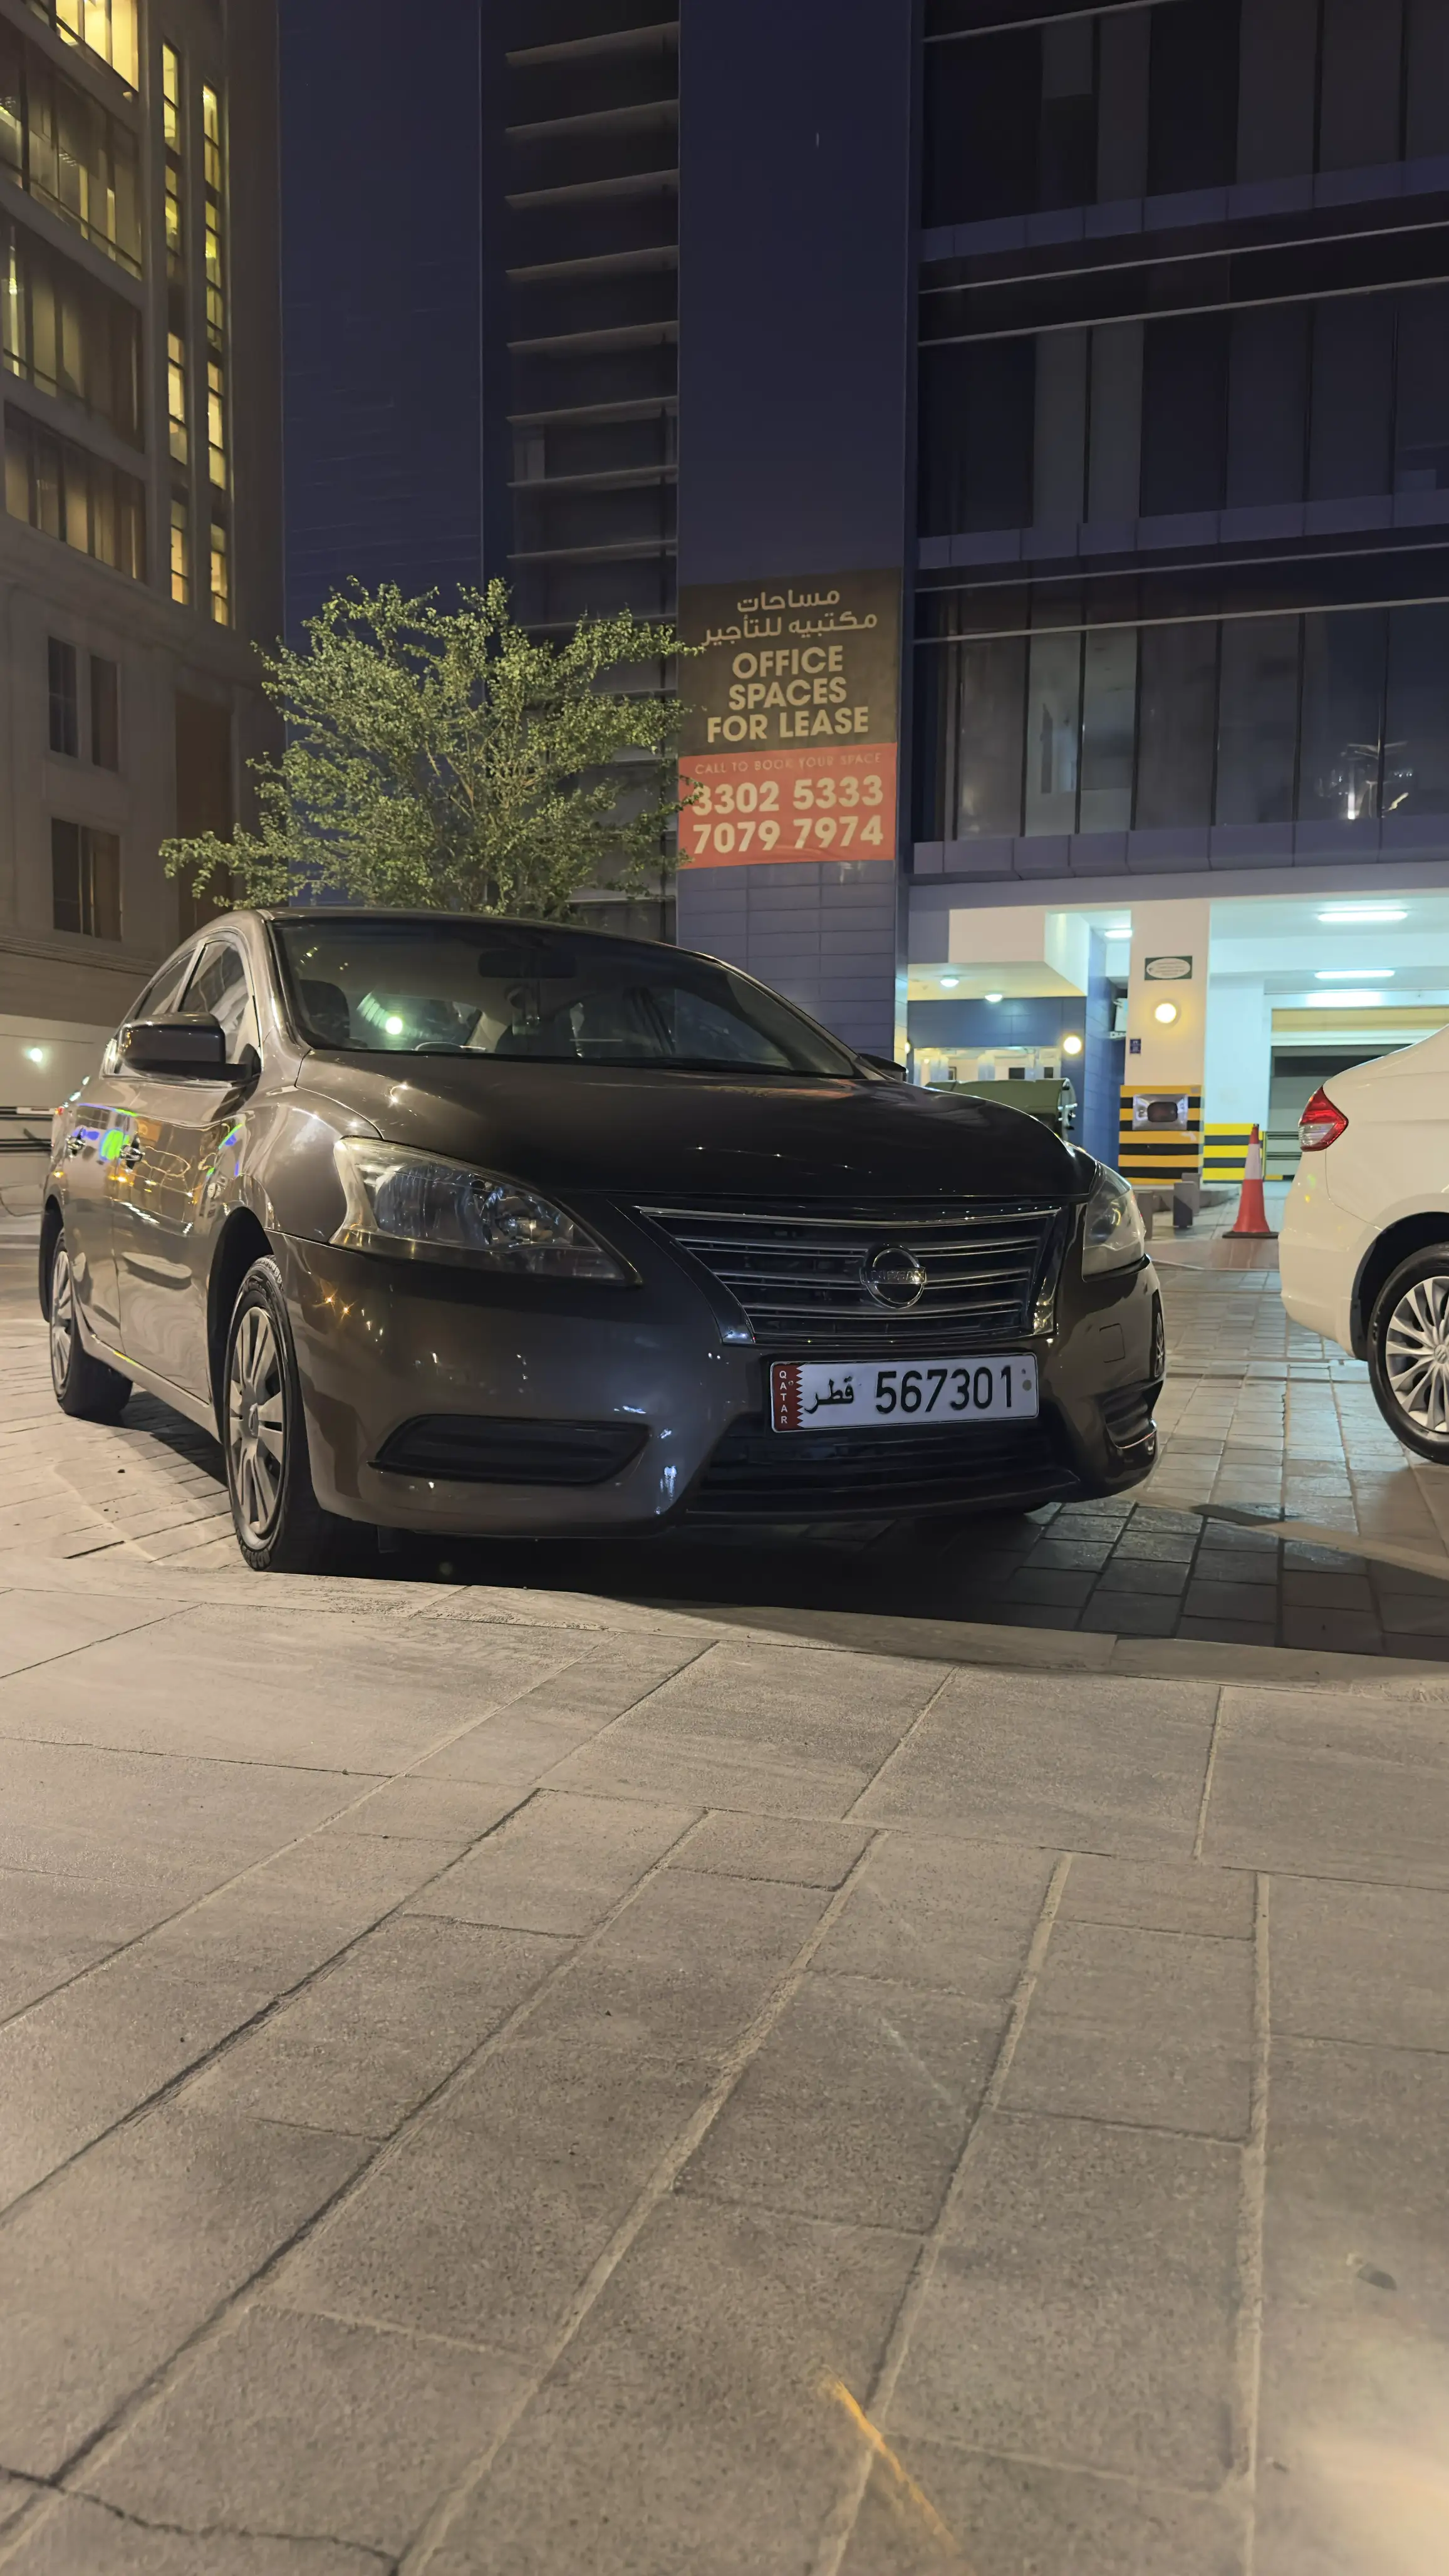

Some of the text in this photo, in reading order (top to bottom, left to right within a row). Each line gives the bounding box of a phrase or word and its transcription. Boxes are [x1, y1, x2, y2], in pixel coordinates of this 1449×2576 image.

[737, 589, 841, 613] مساحات
[701, 615, 782, 647] للتأجير
[732, 645, 843, 679] OFFICE
[729, 677, 847, 710] SPACES
[707, 707, 869, 743] FOR LEASE
[695, 762, 727, 774] CALL
[732, 761, 749, 772] TO
[798, 756, 834, 770] YOUR
[840, 753, 882, 766] SPACE
[692, 775, 883, 816] 3302 5333
[693, 815, 884, 854] 7079 7974
[779, 1370, 788, 1424] QATAR
[804, 1376, 854, 1415] قطر
[875, 1366, 1012, 1414] 567301
